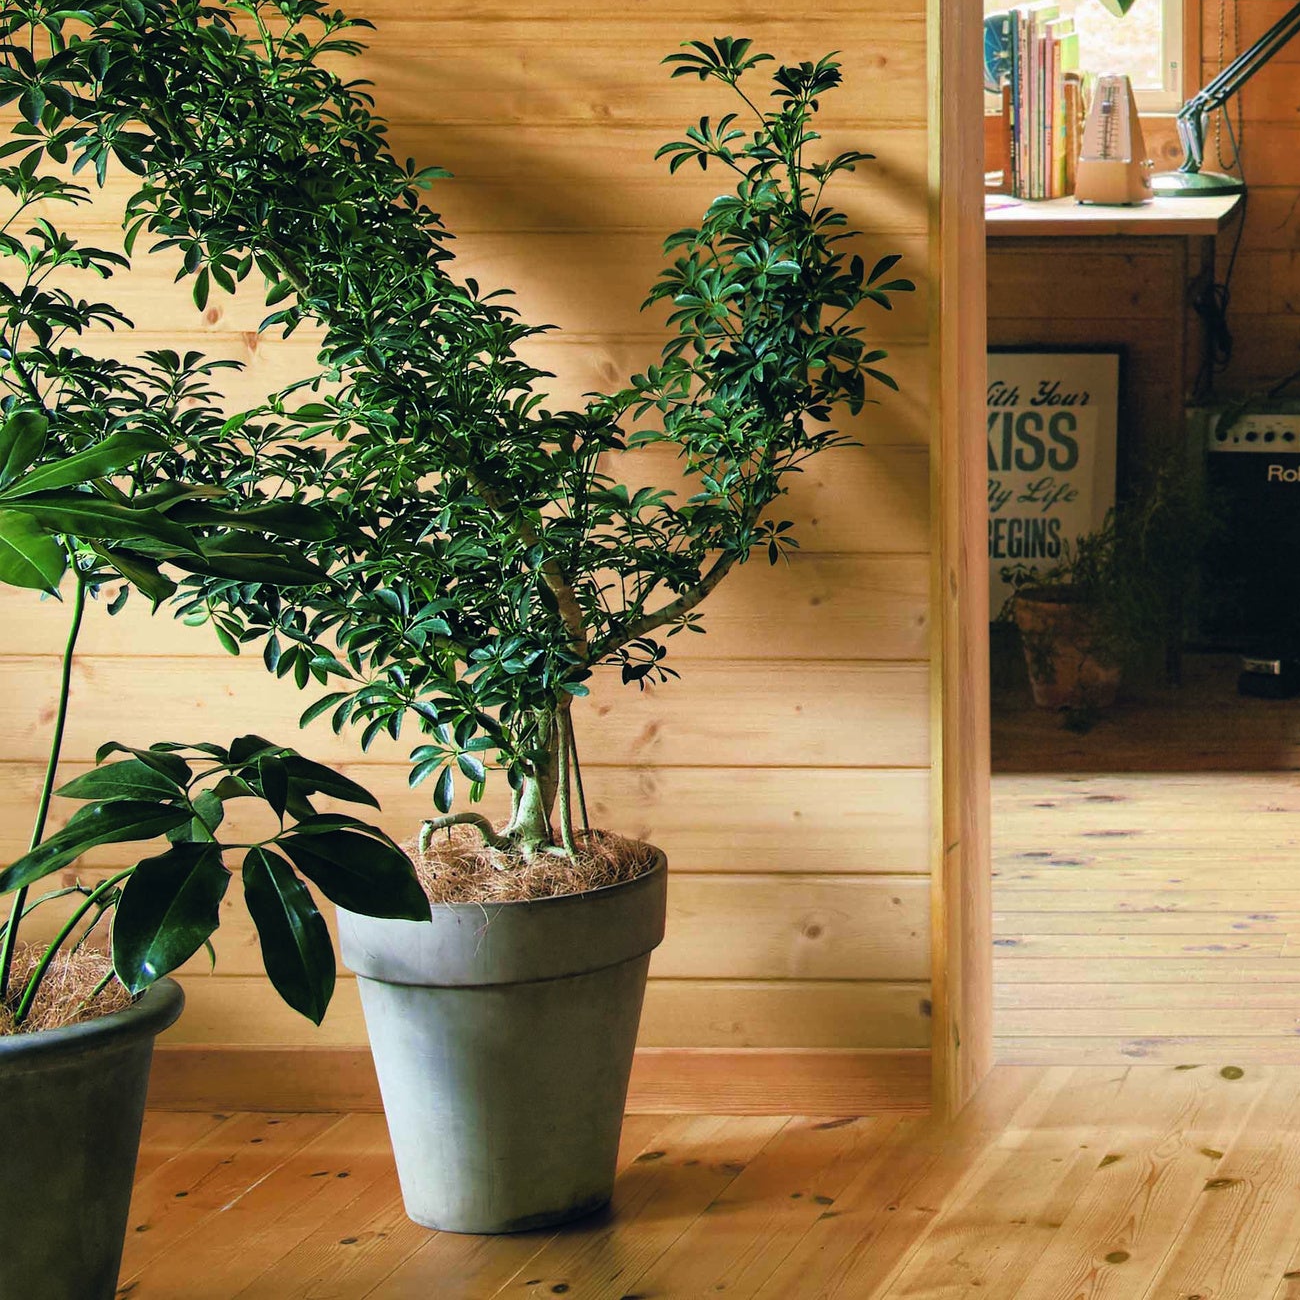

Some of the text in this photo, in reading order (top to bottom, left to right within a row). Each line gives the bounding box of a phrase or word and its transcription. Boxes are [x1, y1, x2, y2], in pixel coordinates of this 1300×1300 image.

[1030, 380, 1090, 407] Your
[1017, 476, 1079, 512] Life
[988, 517, 1061, 560] EGINS
